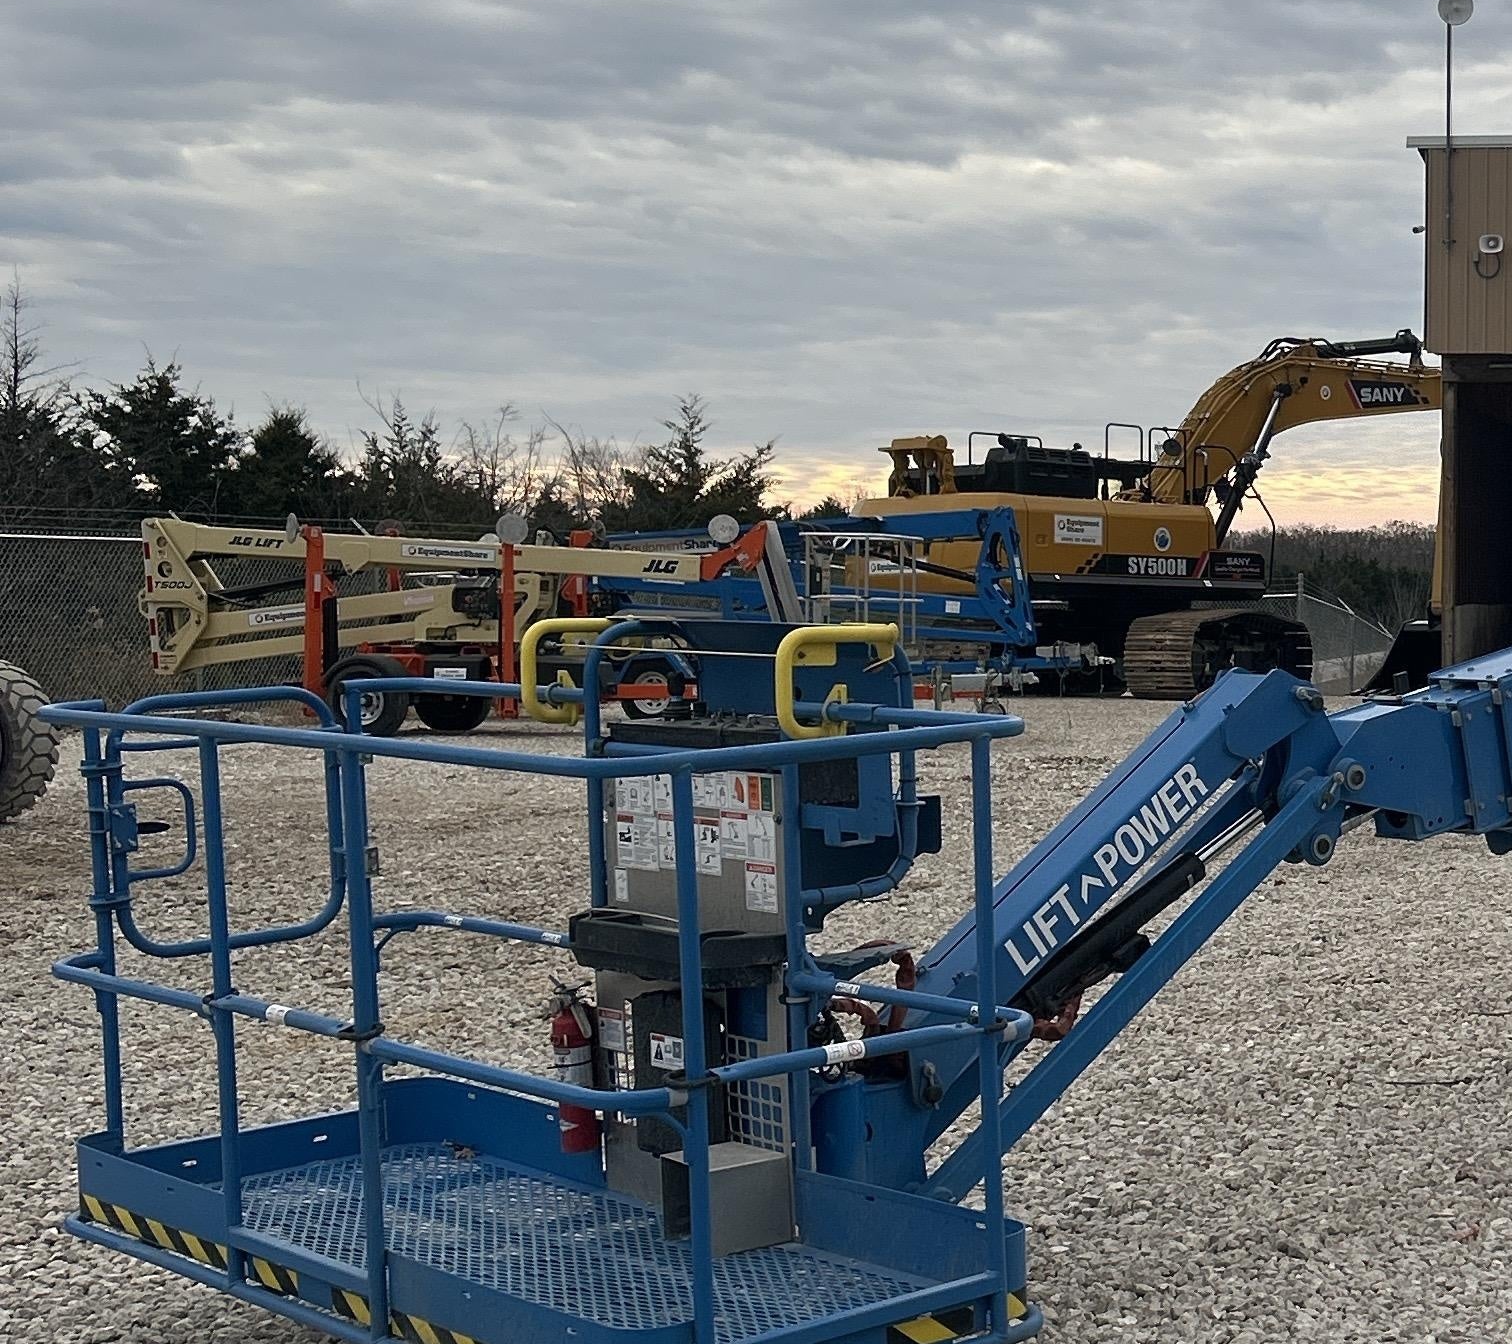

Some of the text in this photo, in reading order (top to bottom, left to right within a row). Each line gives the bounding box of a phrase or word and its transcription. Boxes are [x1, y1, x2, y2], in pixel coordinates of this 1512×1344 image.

[1360, 387, 1405, 402] SANY
[228, 535, 284, 549] JLG LIFT
[417, 546, 489, 559] EquipmentShare
[642, 559, 679, 574] JLG
[1127, 556, 1188, 576] SY500H
[153, 581, 194, 589] T500J
[1004, 763, 1209, 976] LIFT POWER
